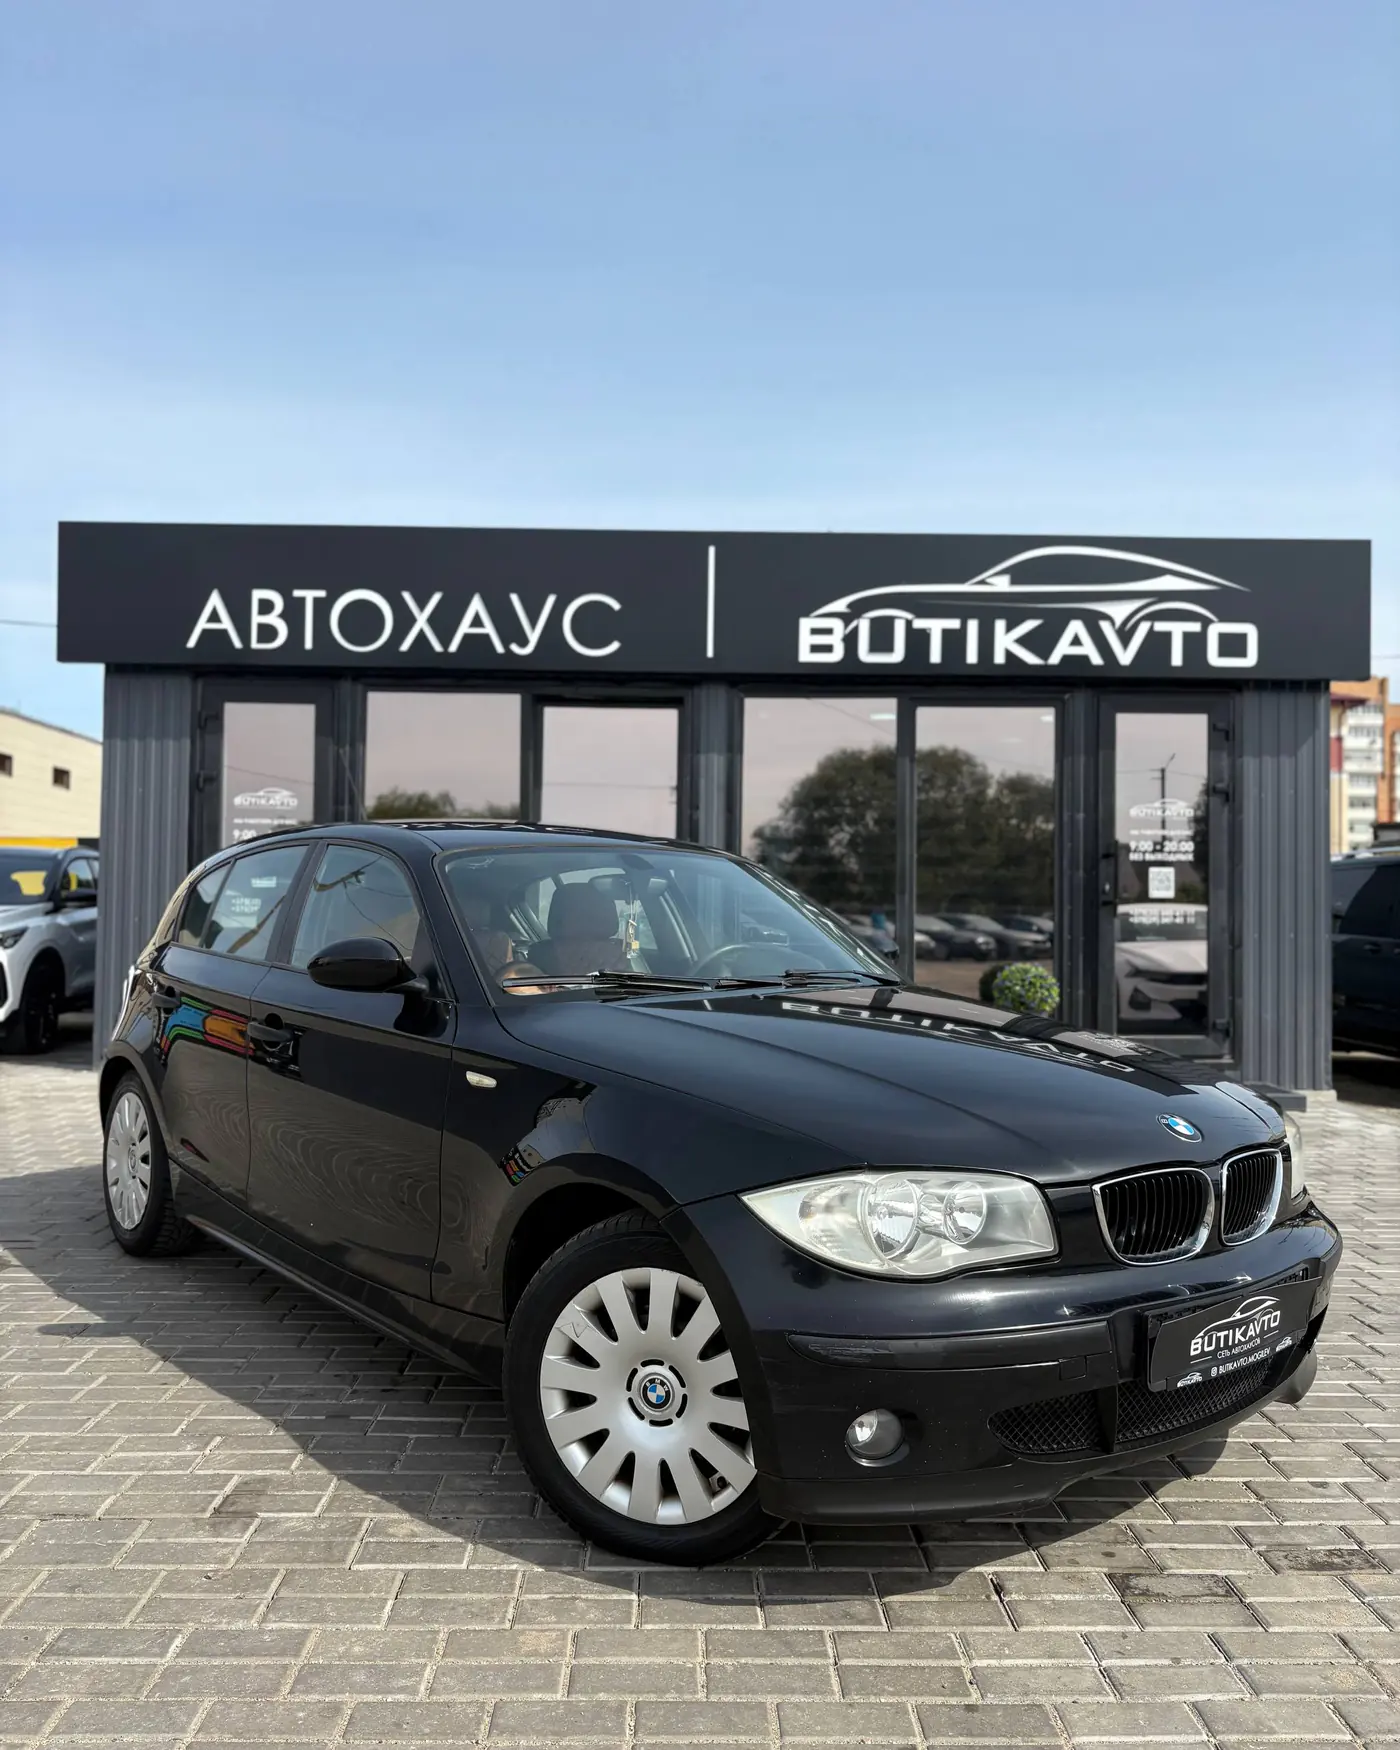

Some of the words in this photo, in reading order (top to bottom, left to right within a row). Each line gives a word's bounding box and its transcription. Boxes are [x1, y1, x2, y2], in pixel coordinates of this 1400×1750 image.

[187, 589, 622, 657] АВТОХАУС
[797, 616, 1260, 668] BUTIKAVTO
[1190, 1310, 1281, 1357] BUTIKAVTO
[1217, 1351, 1231, 1359] СЕТЬ
[645, 1379, 669, 1391] BMW
